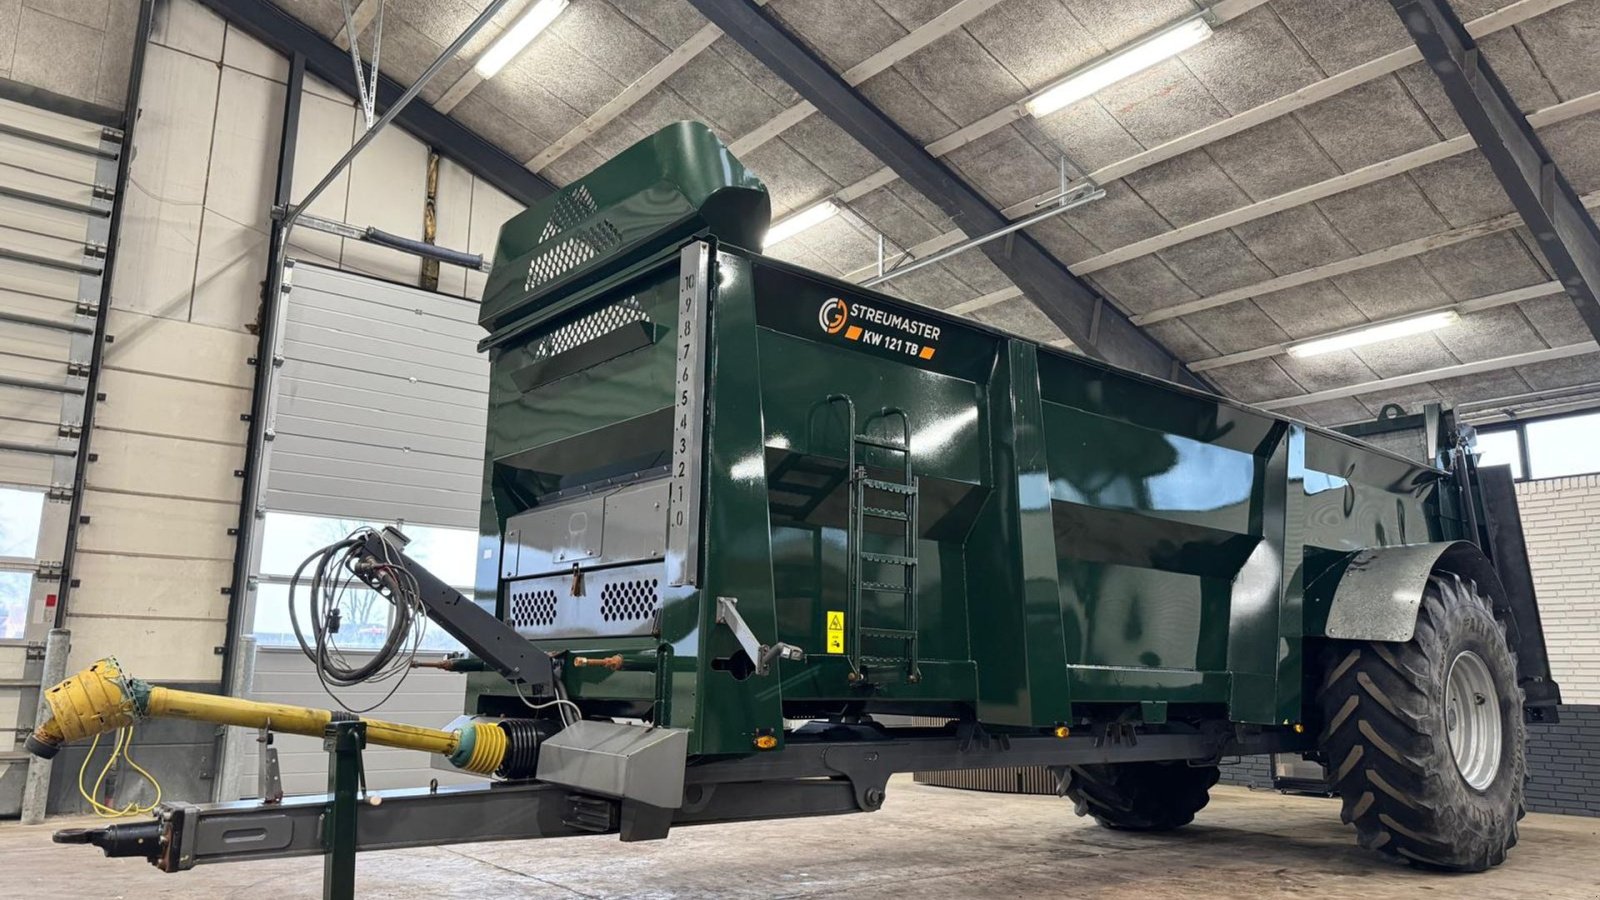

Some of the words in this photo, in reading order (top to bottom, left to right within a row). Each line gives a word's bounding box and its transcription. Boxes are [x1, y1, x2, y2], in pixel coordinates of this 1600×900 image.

[850, 303, 941, 341] STREUMASTER
[862, 329, 882, 346] KW
[884, 336, 901, 351] 121
[904, 341, 919, 355] TB
